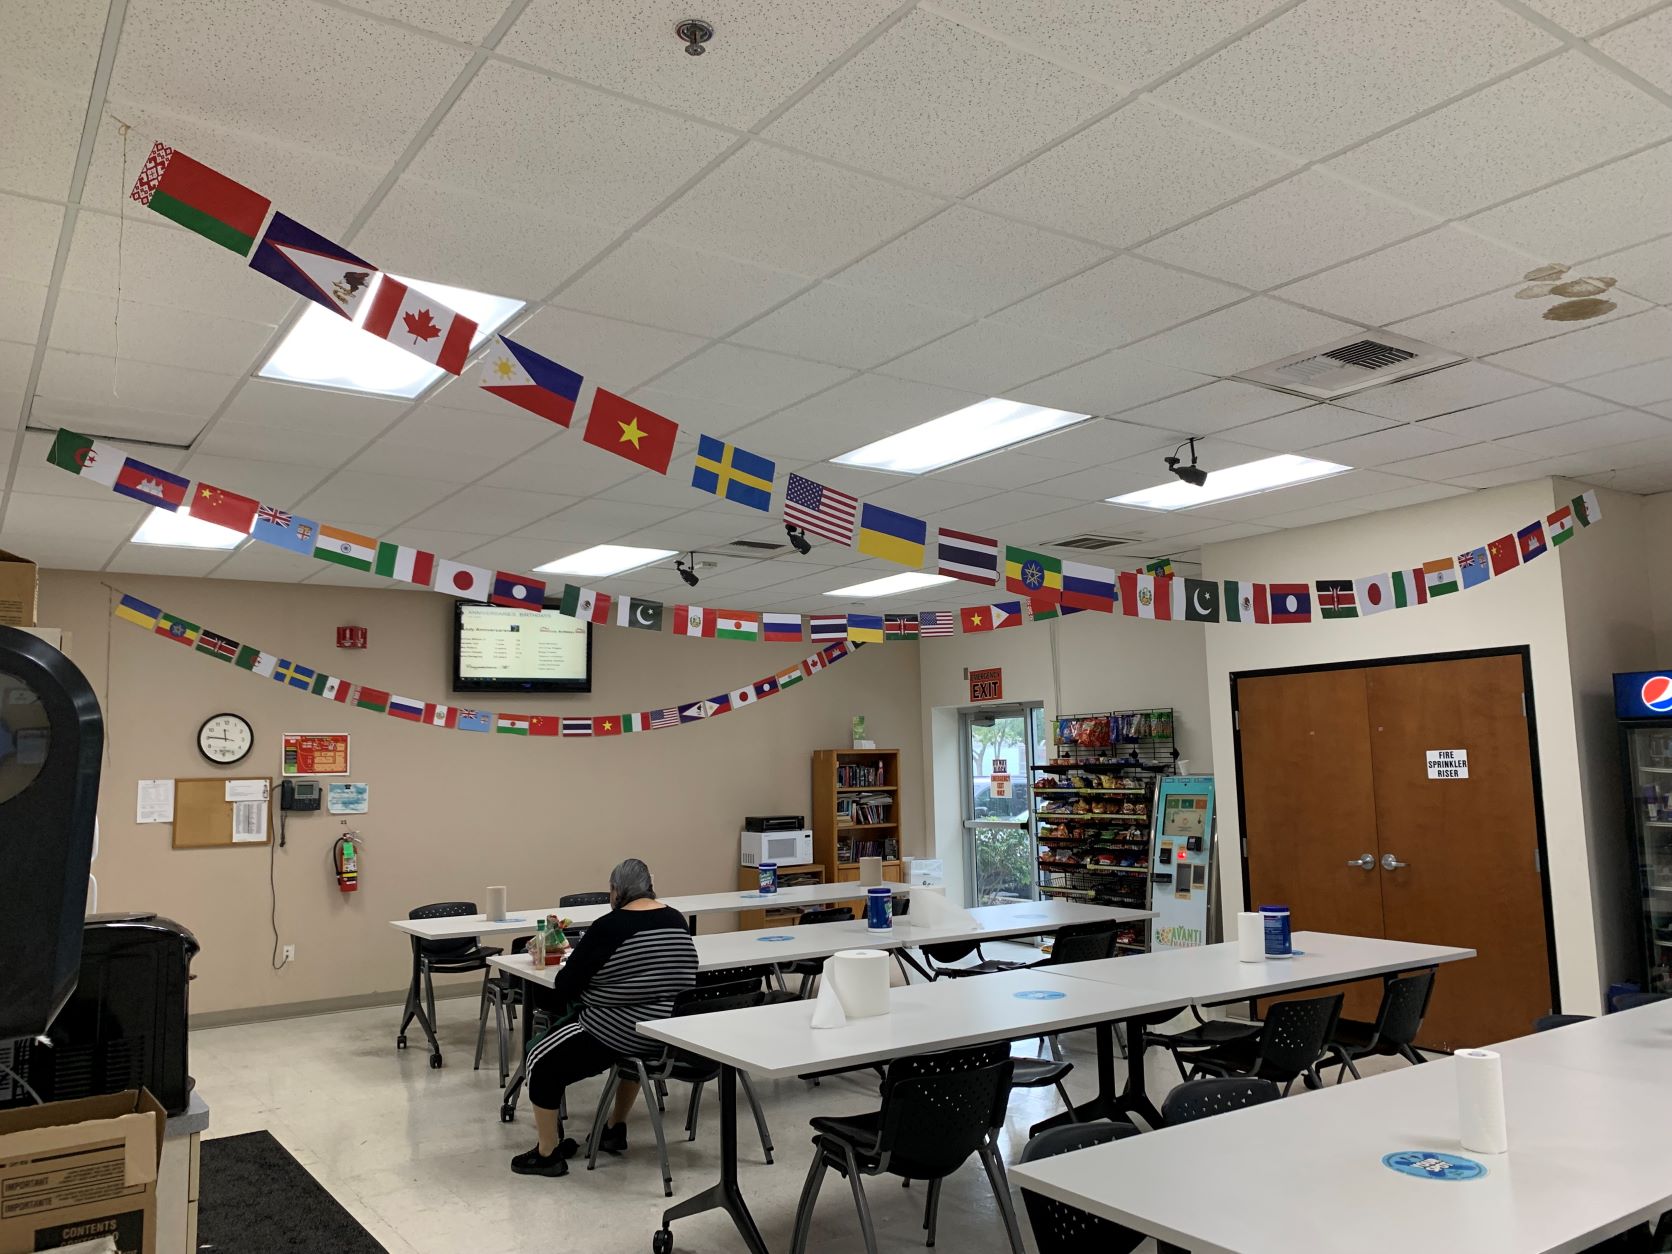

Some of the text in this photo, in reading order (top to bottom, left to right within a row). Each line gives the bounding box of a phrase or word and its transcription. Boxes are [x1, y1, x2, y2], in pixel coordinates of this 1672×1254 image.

[972, 681, 999, 699] EXIT
[1438, 751, 1454, 759] FIRE
[1428, 760, 1467, 769] SPRINKLER
[1437, 769, 1459, 778] RISER
[1171, 926, 1202, 946] AVANTI
[5, 1177, 49, 1192] IMPORTANT
[62, 1219, 118, 1239] CONTENTS
